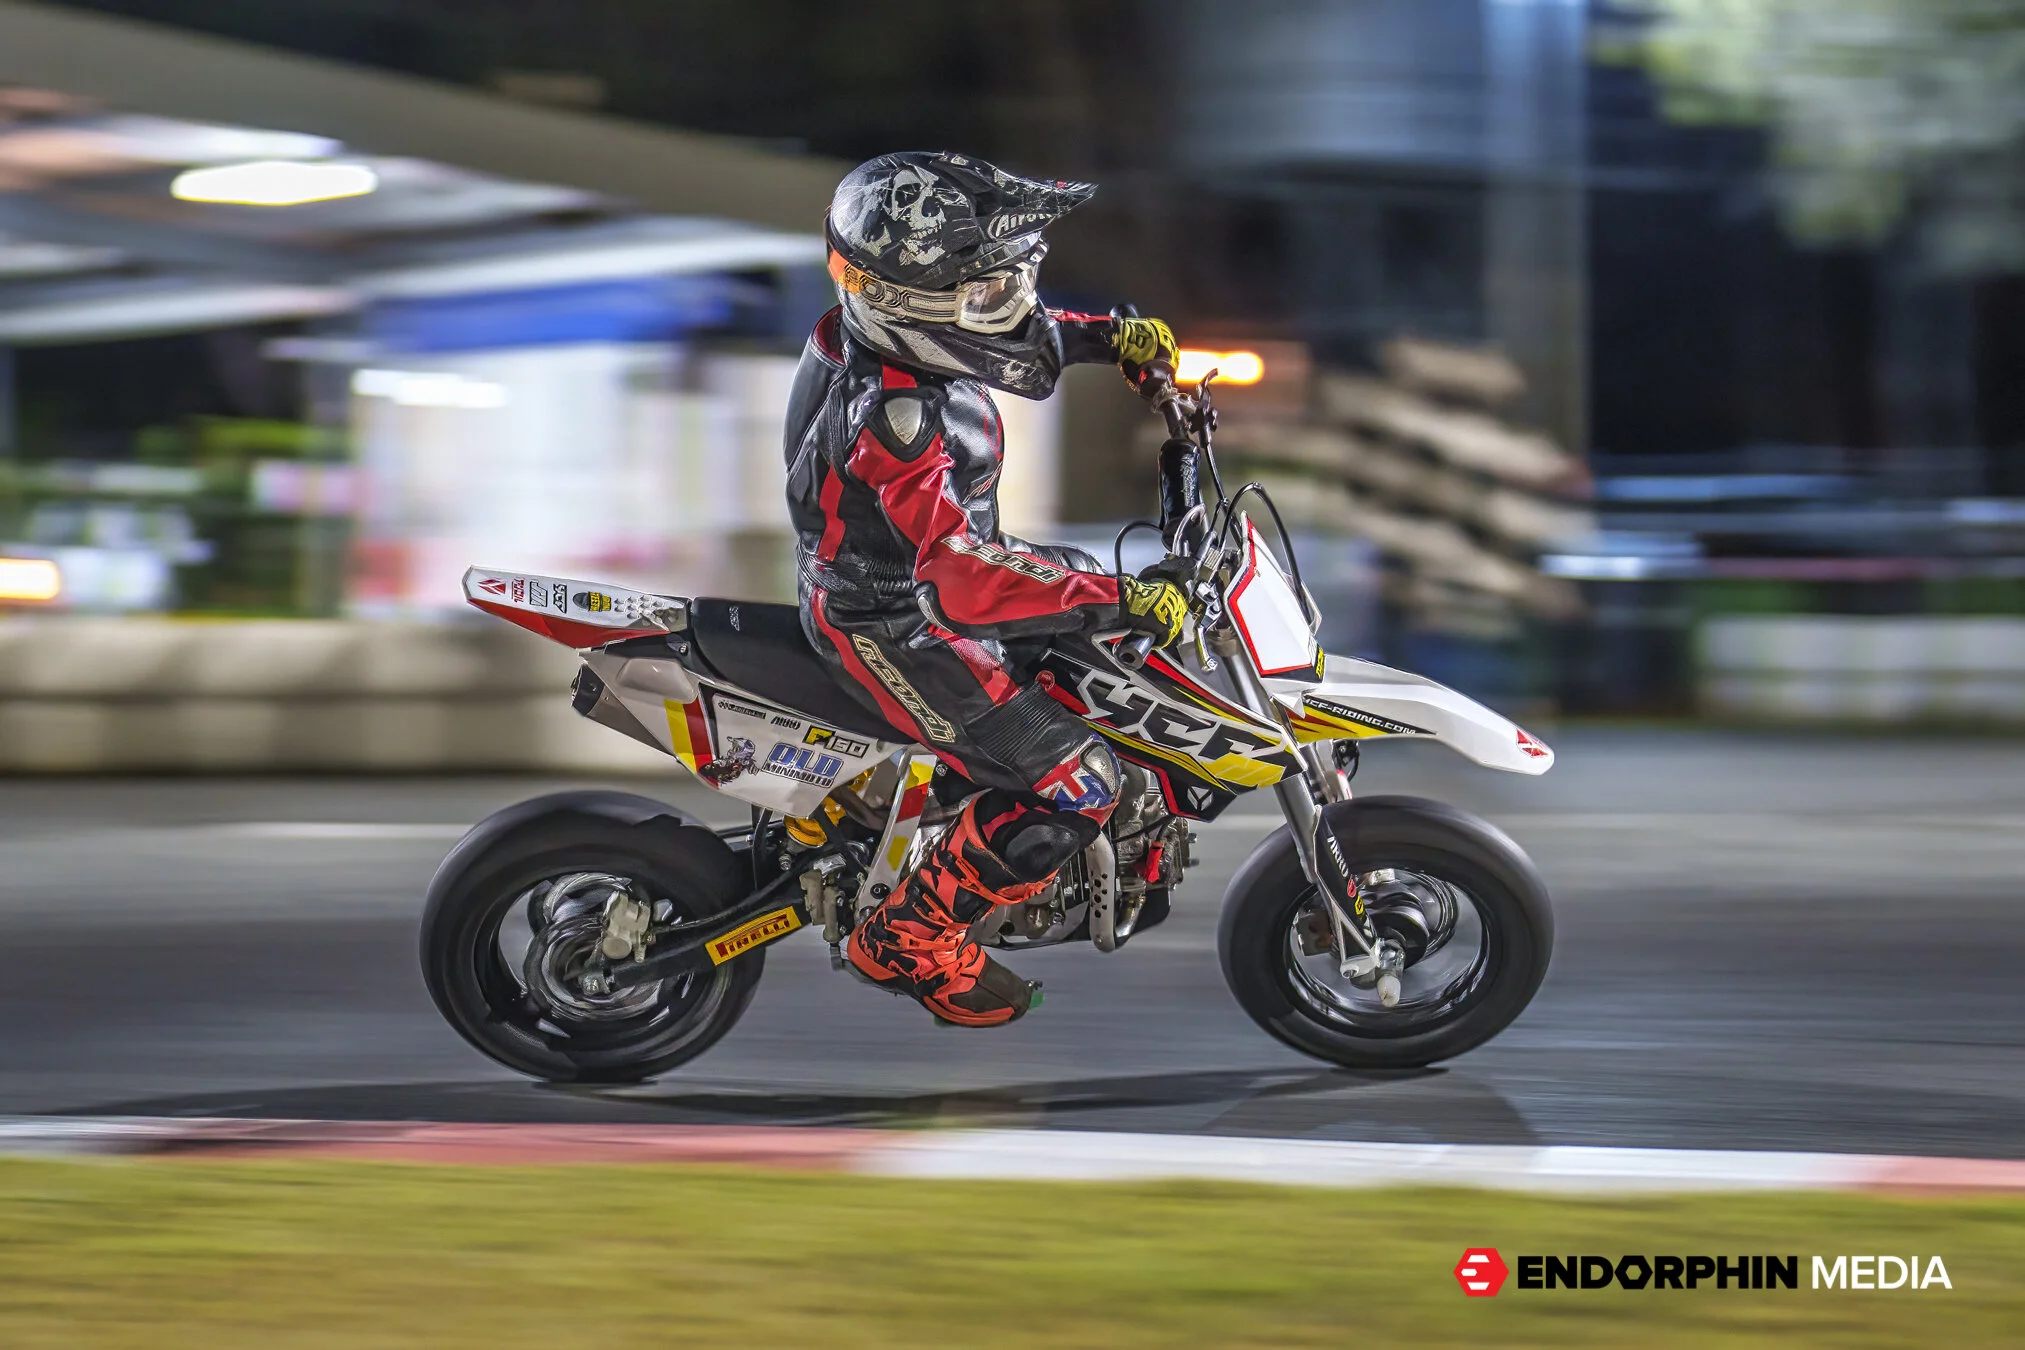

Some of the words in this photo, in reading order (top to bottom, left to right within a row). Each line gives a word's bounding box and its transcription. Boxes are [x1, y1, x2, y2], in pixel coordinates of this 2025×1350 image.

[761, 763, 835, 788] MINIMOTO
[765, 742, 844, 779] QLD
[715, 914, 790, 958] PIRELLI
